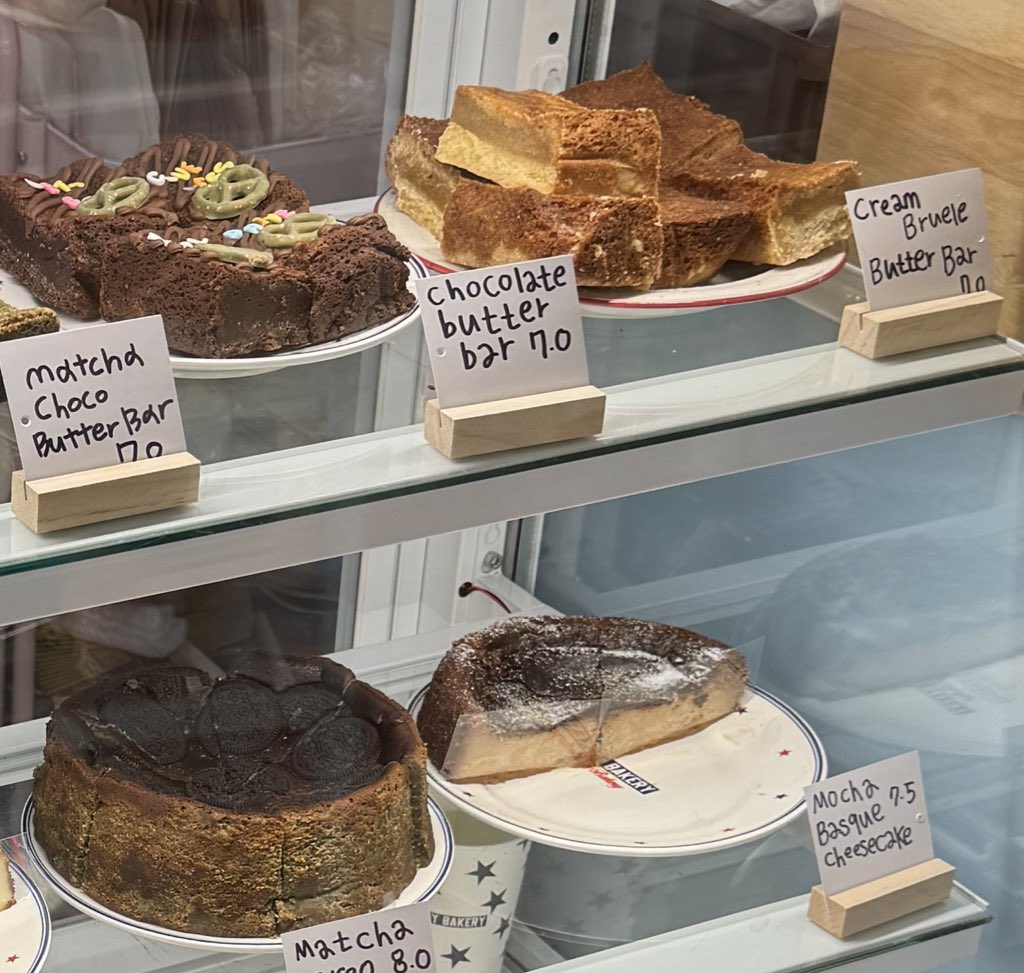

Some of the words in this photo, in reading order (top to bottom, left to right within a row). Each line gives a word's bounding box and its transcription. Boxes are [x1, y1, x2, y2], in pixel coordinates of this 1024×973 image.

[853, 191, 921, 220] Cream
[902, 202, 969, 240] Bruele
[869, 249, 936, 285] Butter
[941, 245, 978, 276] Bar
[438, 297, 550, 339] butter
[460, 337, 515, 370] bar
[529, 328, 571, 359] 7.0
[34, 389, 109, 420] Choco
[32, 420, 120, 458] Butter
[120, 398, 174, 435] Bar
[604, 763, 656, 793] BAKERY
[812, 778, 880, 814] Mocha
[889, 781, 917, 807] 7.5
[816, 803, 885, 847] Basque
[295, 919, 414, 961] Matcha
[442, 916, 487, 928] BAKERY
[391, 949, 431, 973] 8.0
